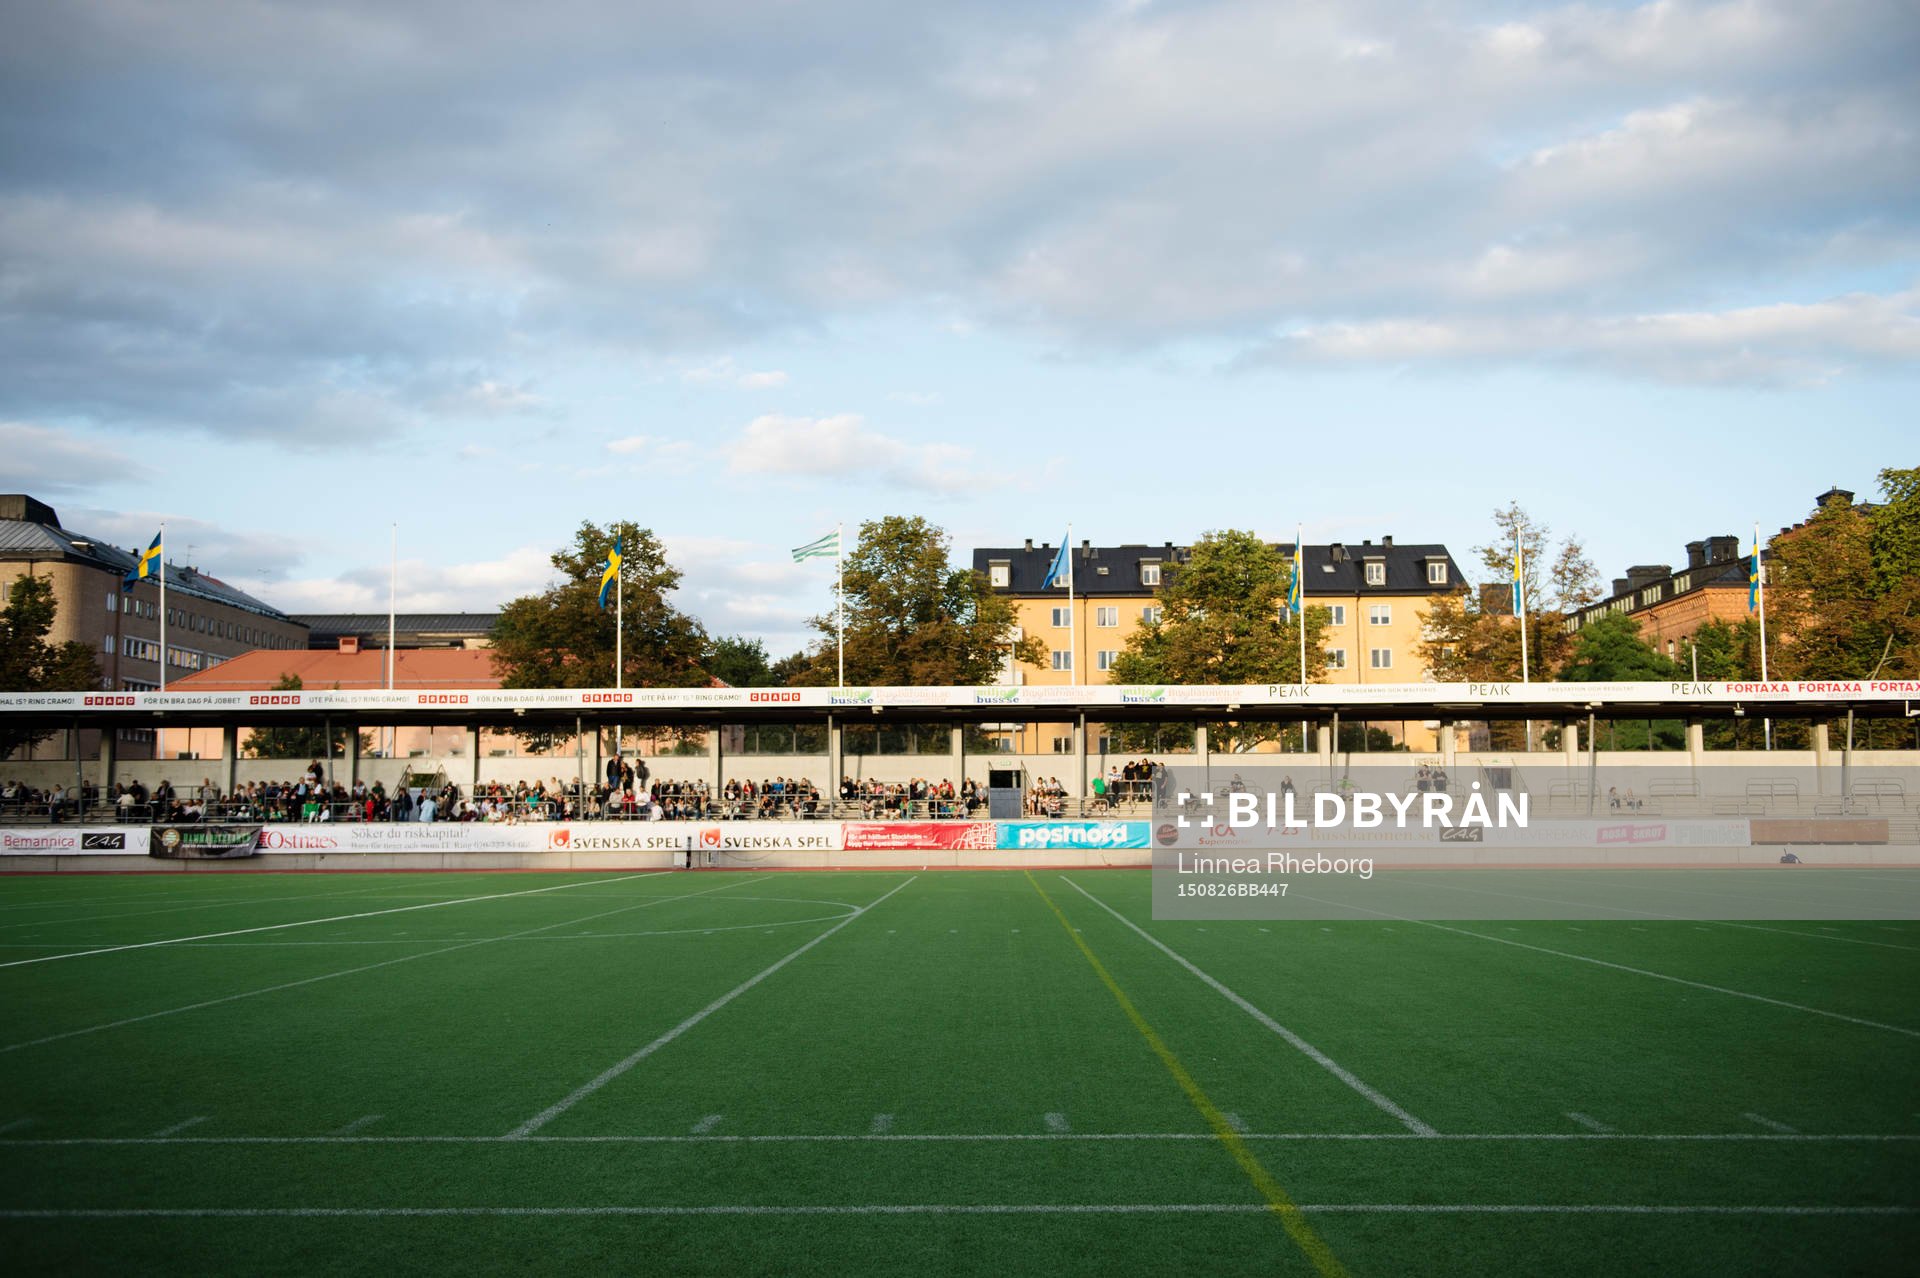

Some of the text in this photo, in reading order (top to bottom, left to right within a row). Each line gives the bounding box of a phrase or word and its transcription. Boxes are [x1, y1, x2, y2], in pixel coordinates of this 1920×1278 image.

[1269, 686, 1310, 697] PEAK
[1469, 684, 1511, 696] PEAK
[1671, 683, 1713, 695] PEAK
[1726, 683, 1790, 693] FORTAXA
[1798, 683, 1862, 692] FORTAXA
[16, 697, 27, 705] IS?
[28, 697, 46, 705] RING
[47, 697, 75, 705] CRAMO!
[84, 696, 135, 706] CRAMO
[144, 696, 158, 704] FÖR
[203, 695, 212, 704] PÅ
[250, 696, 301, 705] CRAMO
[323, 695, 333, 703] PÅ
[418, 695, 468, 704] CRAMO
[582, 694, 632, 703] CRAMO
[750, 692, 800, 702] CRAMO
[351, 828, 384, 839] Söker
[390, 828, 401, 838] du
[1019, 825, 1128, 847] postnord
[1210, 824, 1236, 837] ICA
[1310, 828, 1434, 841] Bussbaronen.se
[1602, 828, 1627, 840] ROSA
[1632, 827, 1662, 840] SKROT
[4, 835, 75, 847] Bemannica
[267, 831, 338, 848] Ostnaes
[574, 837, 682, 848] SVENSKA SPEL
[724, 837, 832, 848] SVENSKA SPEL
